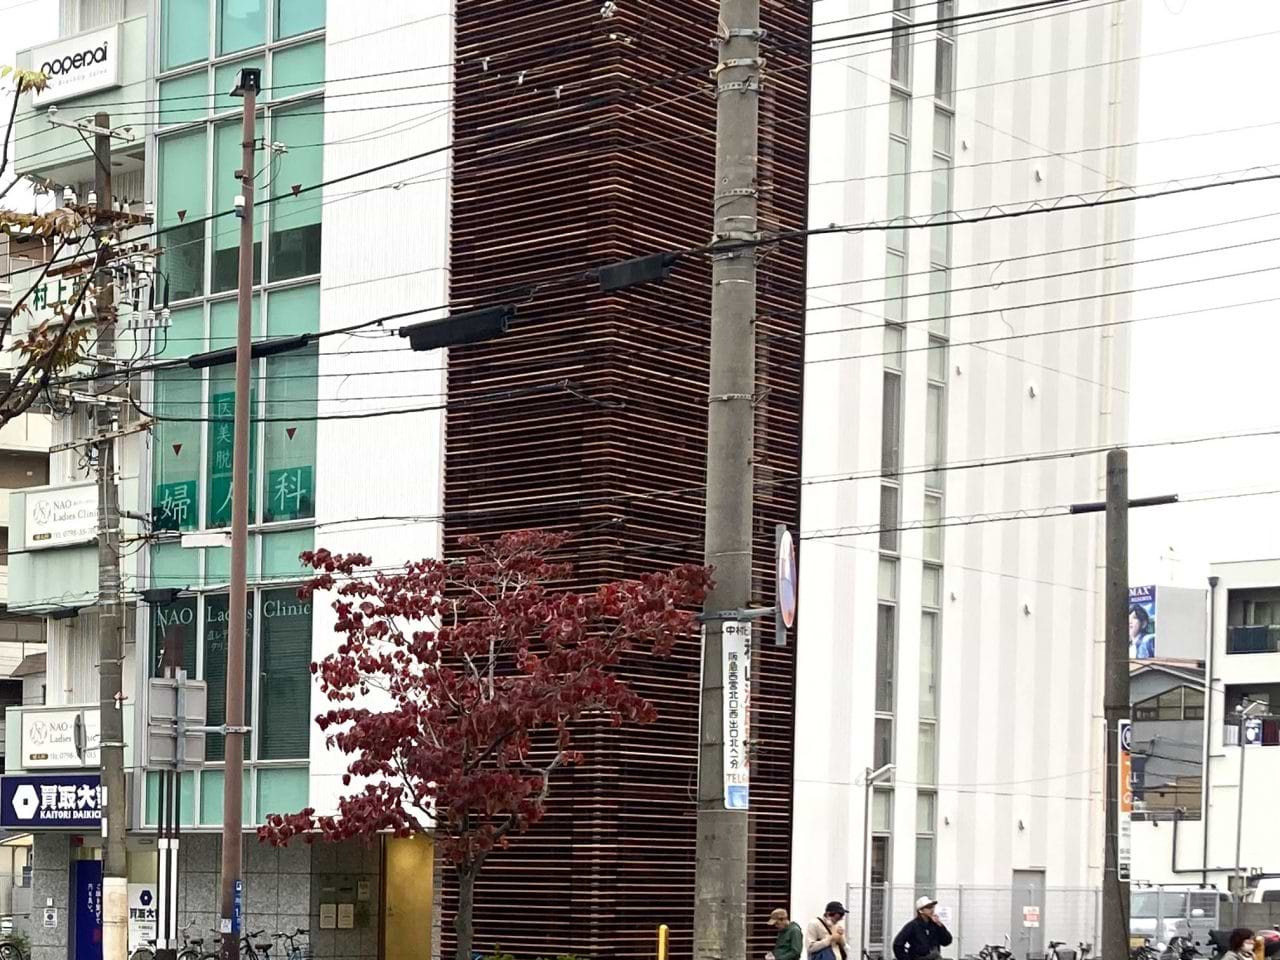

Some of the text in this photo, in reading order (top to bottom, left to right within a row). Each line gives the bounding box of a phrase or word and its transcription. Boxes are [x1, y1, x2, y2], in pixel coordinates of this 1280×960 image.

[157, 607, 193, 626] NAO
[263, 600, 312, 618] Clinic
[40, 810, 71, 819] KAITORI
